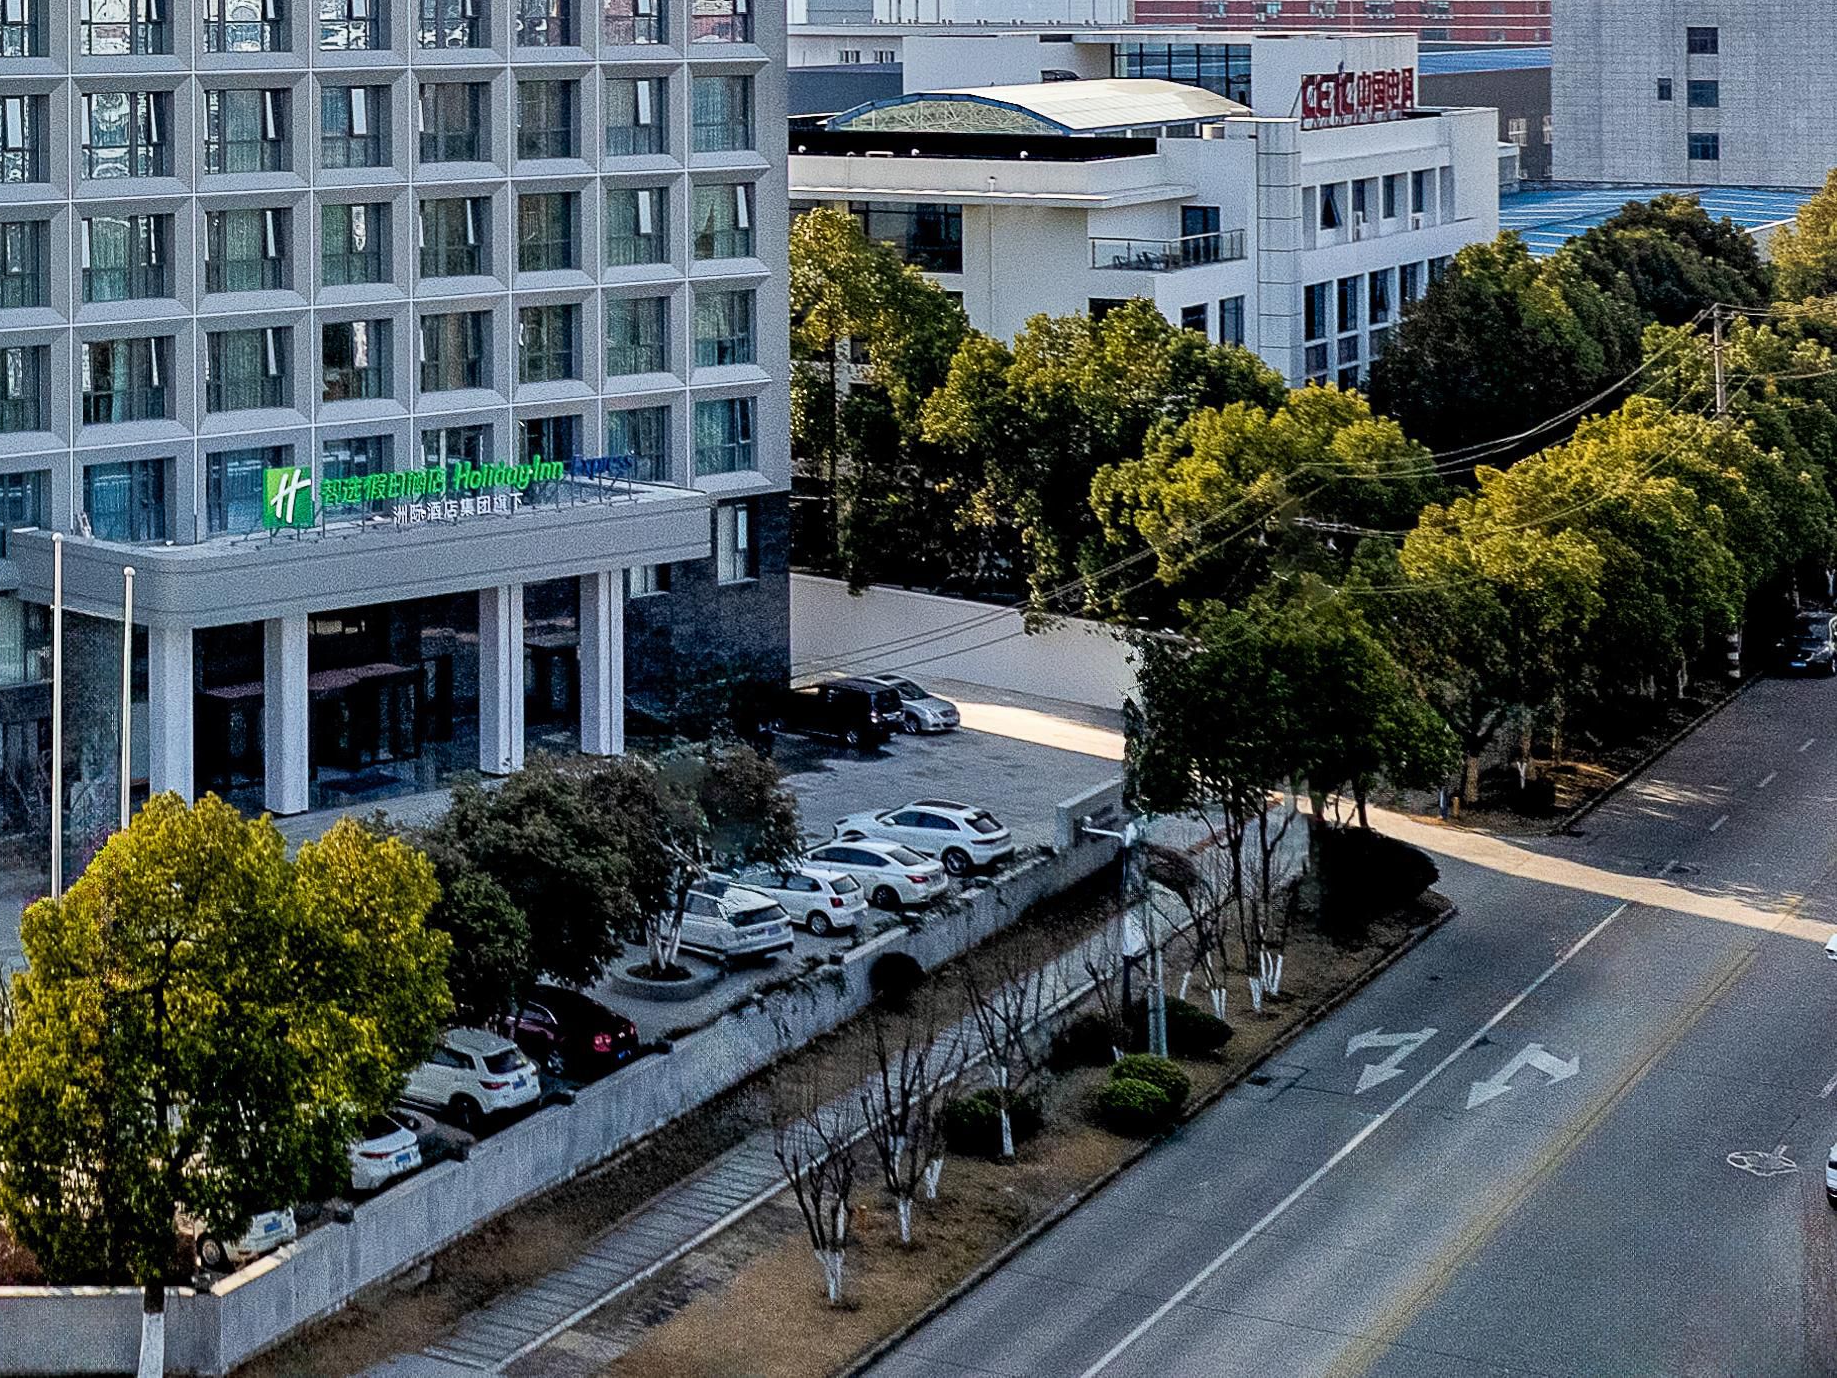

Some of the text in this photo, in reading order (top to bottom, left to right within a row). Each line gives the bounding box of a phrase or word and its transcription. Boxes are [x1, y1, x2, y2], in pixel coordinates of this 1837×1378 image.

[321, 465, 446, 506] 智选假日酒店
[453, 459, 533, 490] Holiday
[532, 454, 564, 481] Inn
[393, 492, 524, 525] 洲际酒店集团旗下
